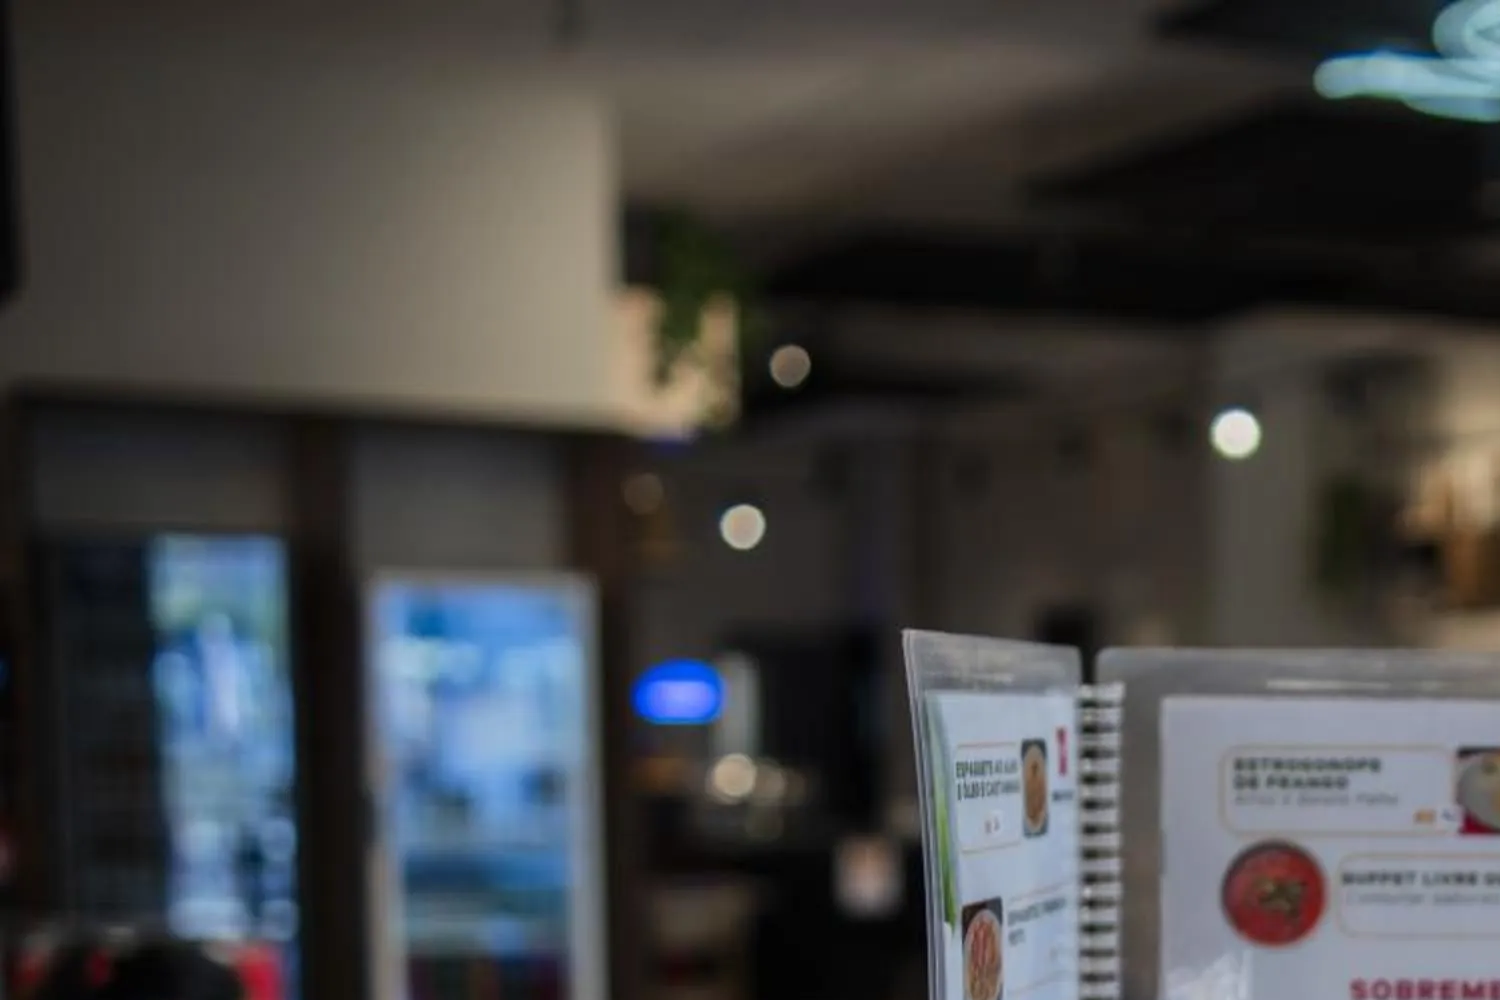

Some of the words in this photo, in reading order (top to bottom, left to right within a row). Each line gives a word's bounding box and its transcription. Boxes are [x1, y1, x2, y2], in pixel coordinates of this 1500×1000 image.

[1234, 775, 1259, 789] DE
[1266, 775, 1348, 789] FRANGO
[1342, 871, 1417, 886] BUFFET
[1422, 871, 1478, 886] LIVRE
